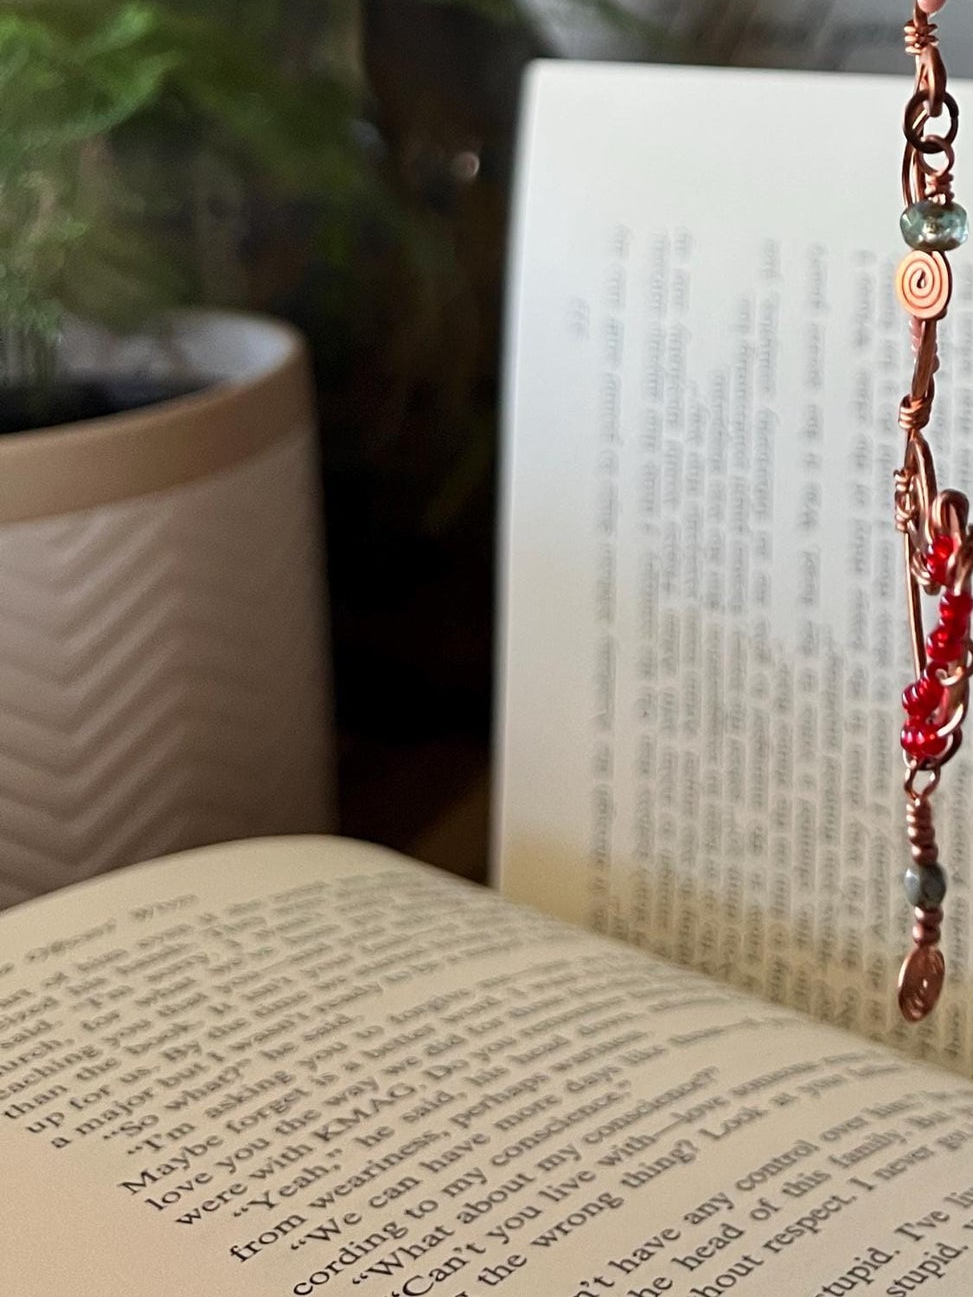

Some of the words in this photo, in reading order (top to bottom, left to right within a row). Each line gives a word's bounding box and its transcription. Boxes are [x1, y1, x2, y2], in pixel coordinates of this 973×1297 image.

[5, 1084, 67, 1119] than
[25, 1111, 65, 1134] up
[70, 1084, 111, 1110] for
[51, 1135, 72, 1149] a
[74, 1087, 154, 1135] major
[102, 1114, 159, 1140] “So
[118, 1134, 224, 1195] Maybe
[224, 1087, 311, 1135] forget
[311, 1073, 338, 1087] is
[144, 1171, 213, 1211] love
[216, 1137, 270, 1174] you
[274, 1109, 322, 1135] the
[324, 1077, 379, 1106] way
[382, 1056, 423, 1074] we
[205, 1071, 296, 1119] asking
[175, 1183, 248, 1226] were
[249, 1141, 314, 1181] with
[229, 1214, 306, 1263] from
[308, 1130, 451, 1210] weariness,
[451, 1073, 549, 1130] perhaps
[233, 1148, 343, 1217] “Yeah,”
[354, 1126, 395, 1148] he
[402, 1090, 467, 1123] said,
[290, 1211, 362, 1251] “We
[368, 1175, 420, 1208] can
[419, 1133, 491, 1175] have
[494, 1095, 561, 1131] more
[293, 1221, 409, 1296] cording
[404, 1198, 439, 1221] to
[442, 1166, 488, 1197] my
[490, 1079, 631, 1167] conscience.”
[478, 1251, 527, 1288] the
[531, 1191, 624, 1249] wrong
[620, 1138, 701, 1190] thing?
[699, 1106, 769, 1141] Look
[486, 1204, 542, 1244] you
[538, 1168, 596, 1203] live
[609, 1226, 681, 1275] have
[683, 1191, 735, 1227] any
[735, 1139, 820, 1192] control
[820, 1116, 868, 1143] over
[762, 1193, 857, 1253] respect.
[848, 1177, 876, 1191] I
[873, 1145, 936, 1180] never
[352, 1224, 455, 1285] “What
[456, 1171, 536, 1224] about
[537, 1142, 582, 1174] my
[672, 1223, 746, 1271] head
[750, 1197, 780, 1221] of
[781, 1168, 831, 1199] this
[895, 1210, 950, 1241] I've
[886, 1242, 969, 1297] stupid.
